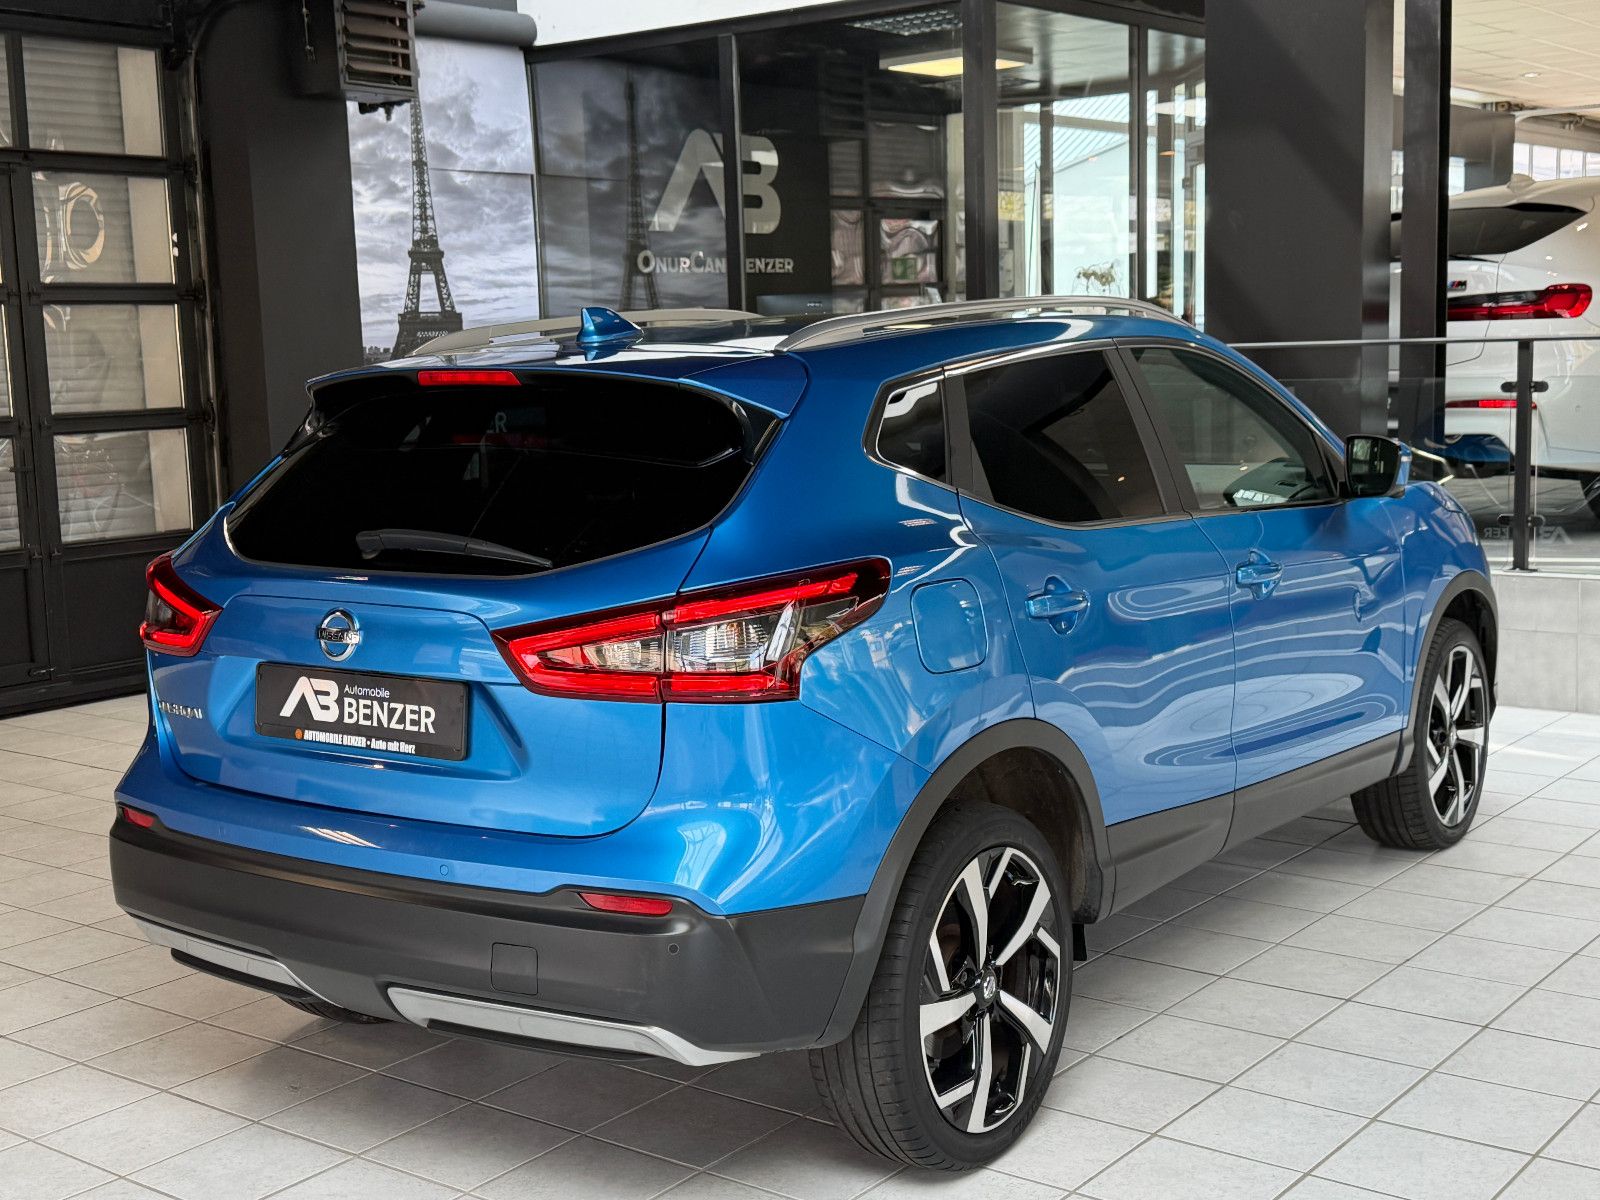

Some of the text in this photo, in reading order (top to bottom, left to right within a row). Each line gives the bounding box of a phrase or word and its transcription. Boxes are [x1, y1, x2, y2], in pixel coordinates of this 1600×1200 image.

[648, 128, 781, 234] AB
[746, 258, 794, 273] ENZER
[320, 630, 354, 643] NISSAN
[279, 676, 340, 723] AB
[344, 684, 390, 699] Automobile
[343, 697, 436, 734] BENZER
[304, 729, 343, 745] AUTOMOBILE
